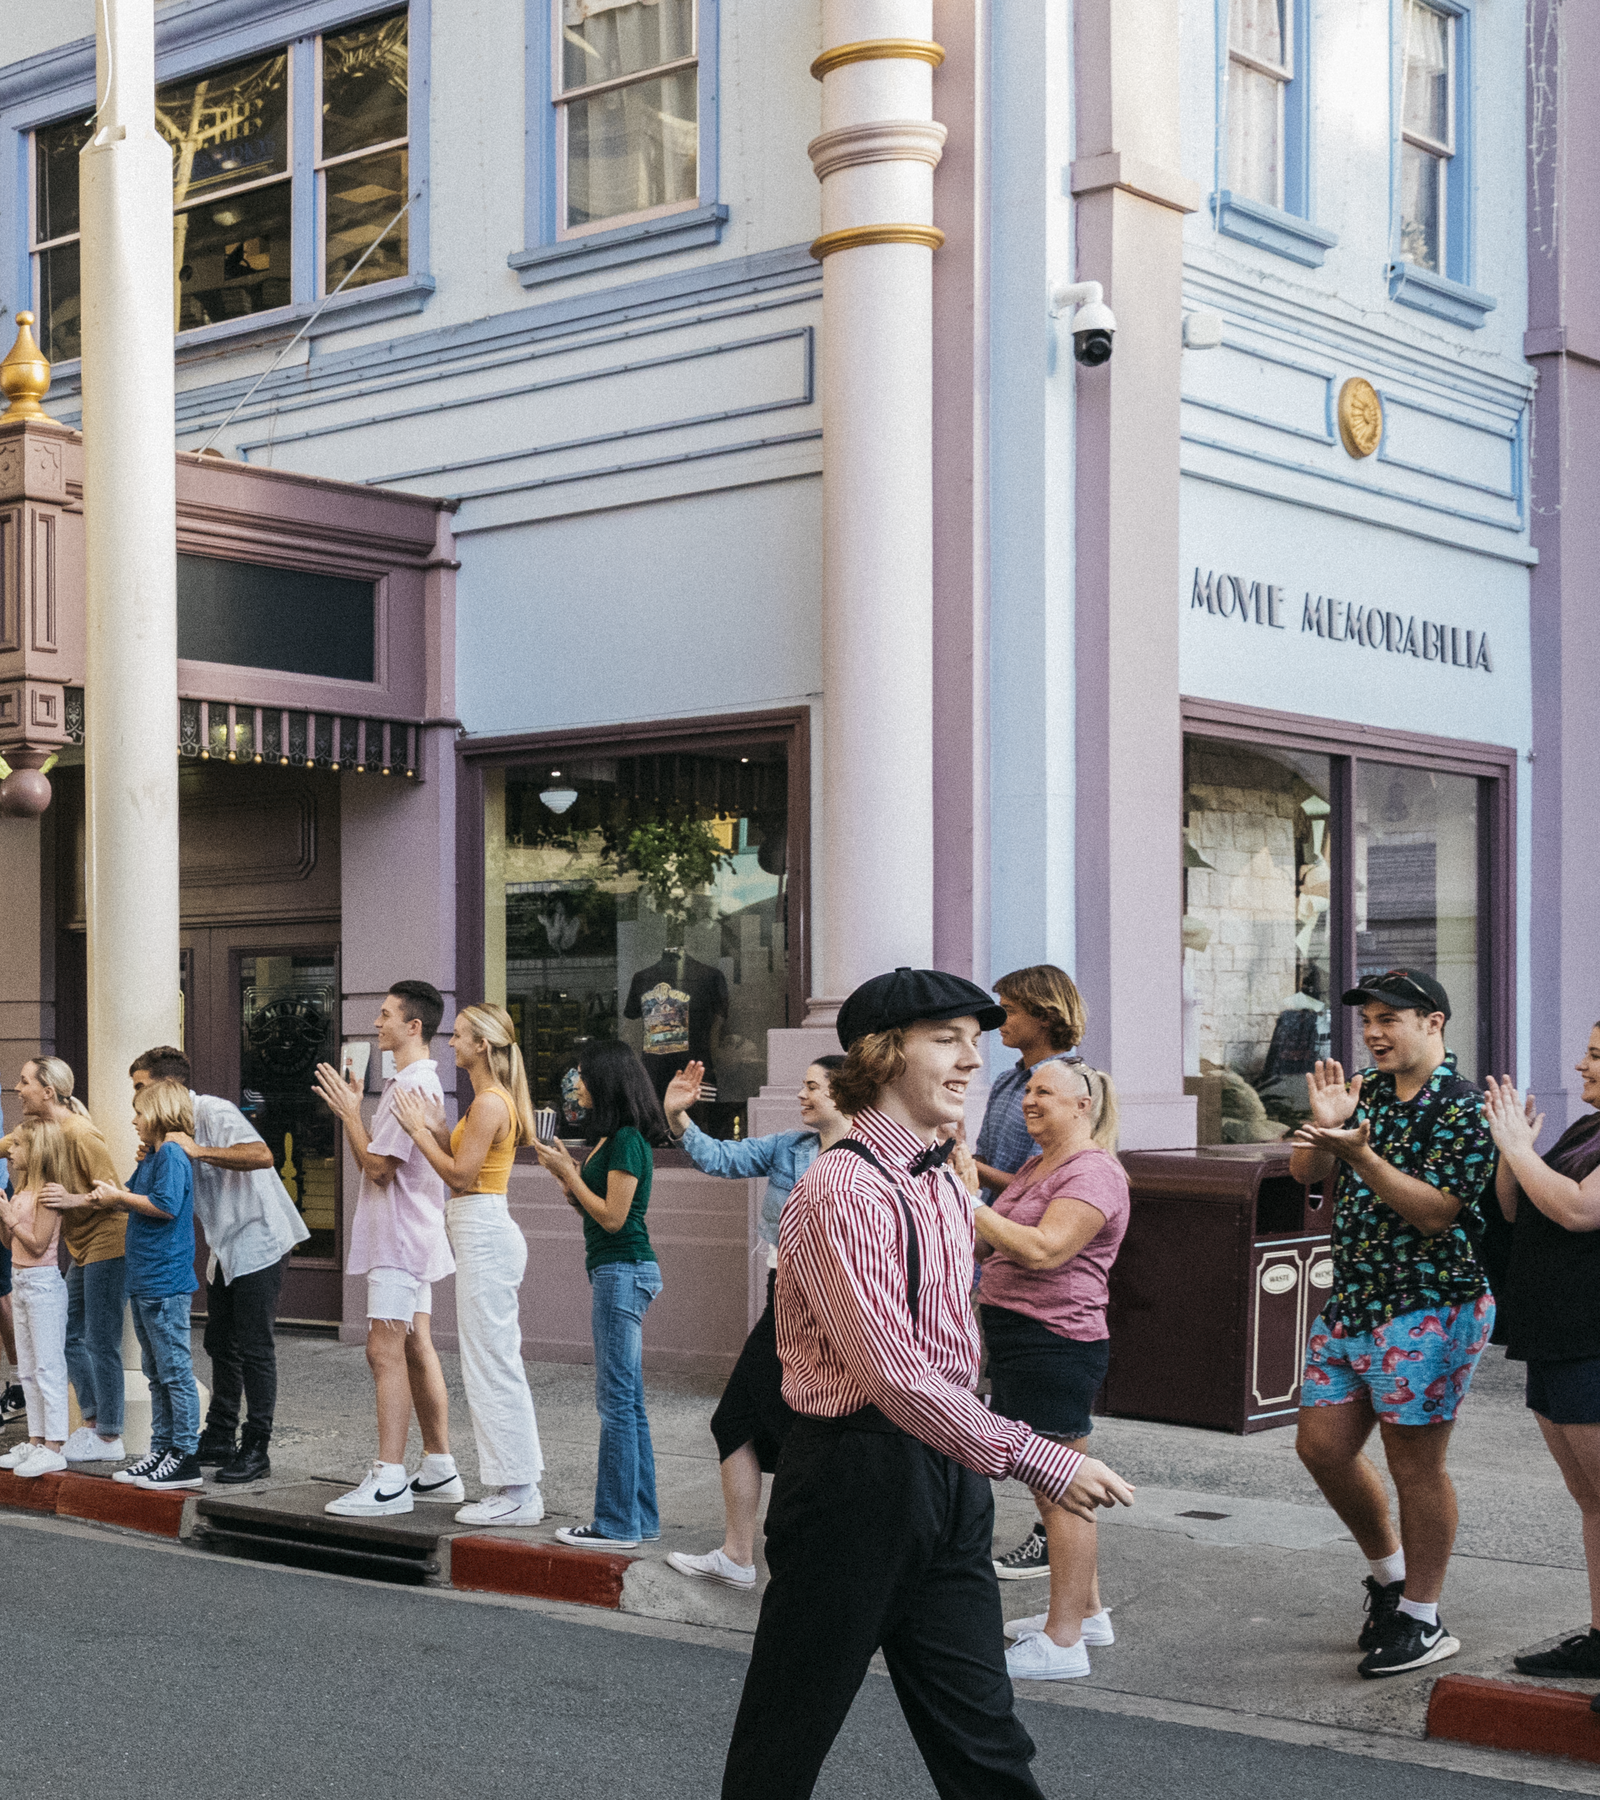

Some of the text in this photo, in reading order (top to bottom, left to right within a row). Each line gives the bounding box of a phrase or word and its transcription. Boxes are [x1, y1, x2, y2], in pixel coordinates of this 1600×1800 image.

[1191, 567, 1494, 673] MOVIE MEMORABILIA
[1269, 1274, 1290, 1283] WASTE
